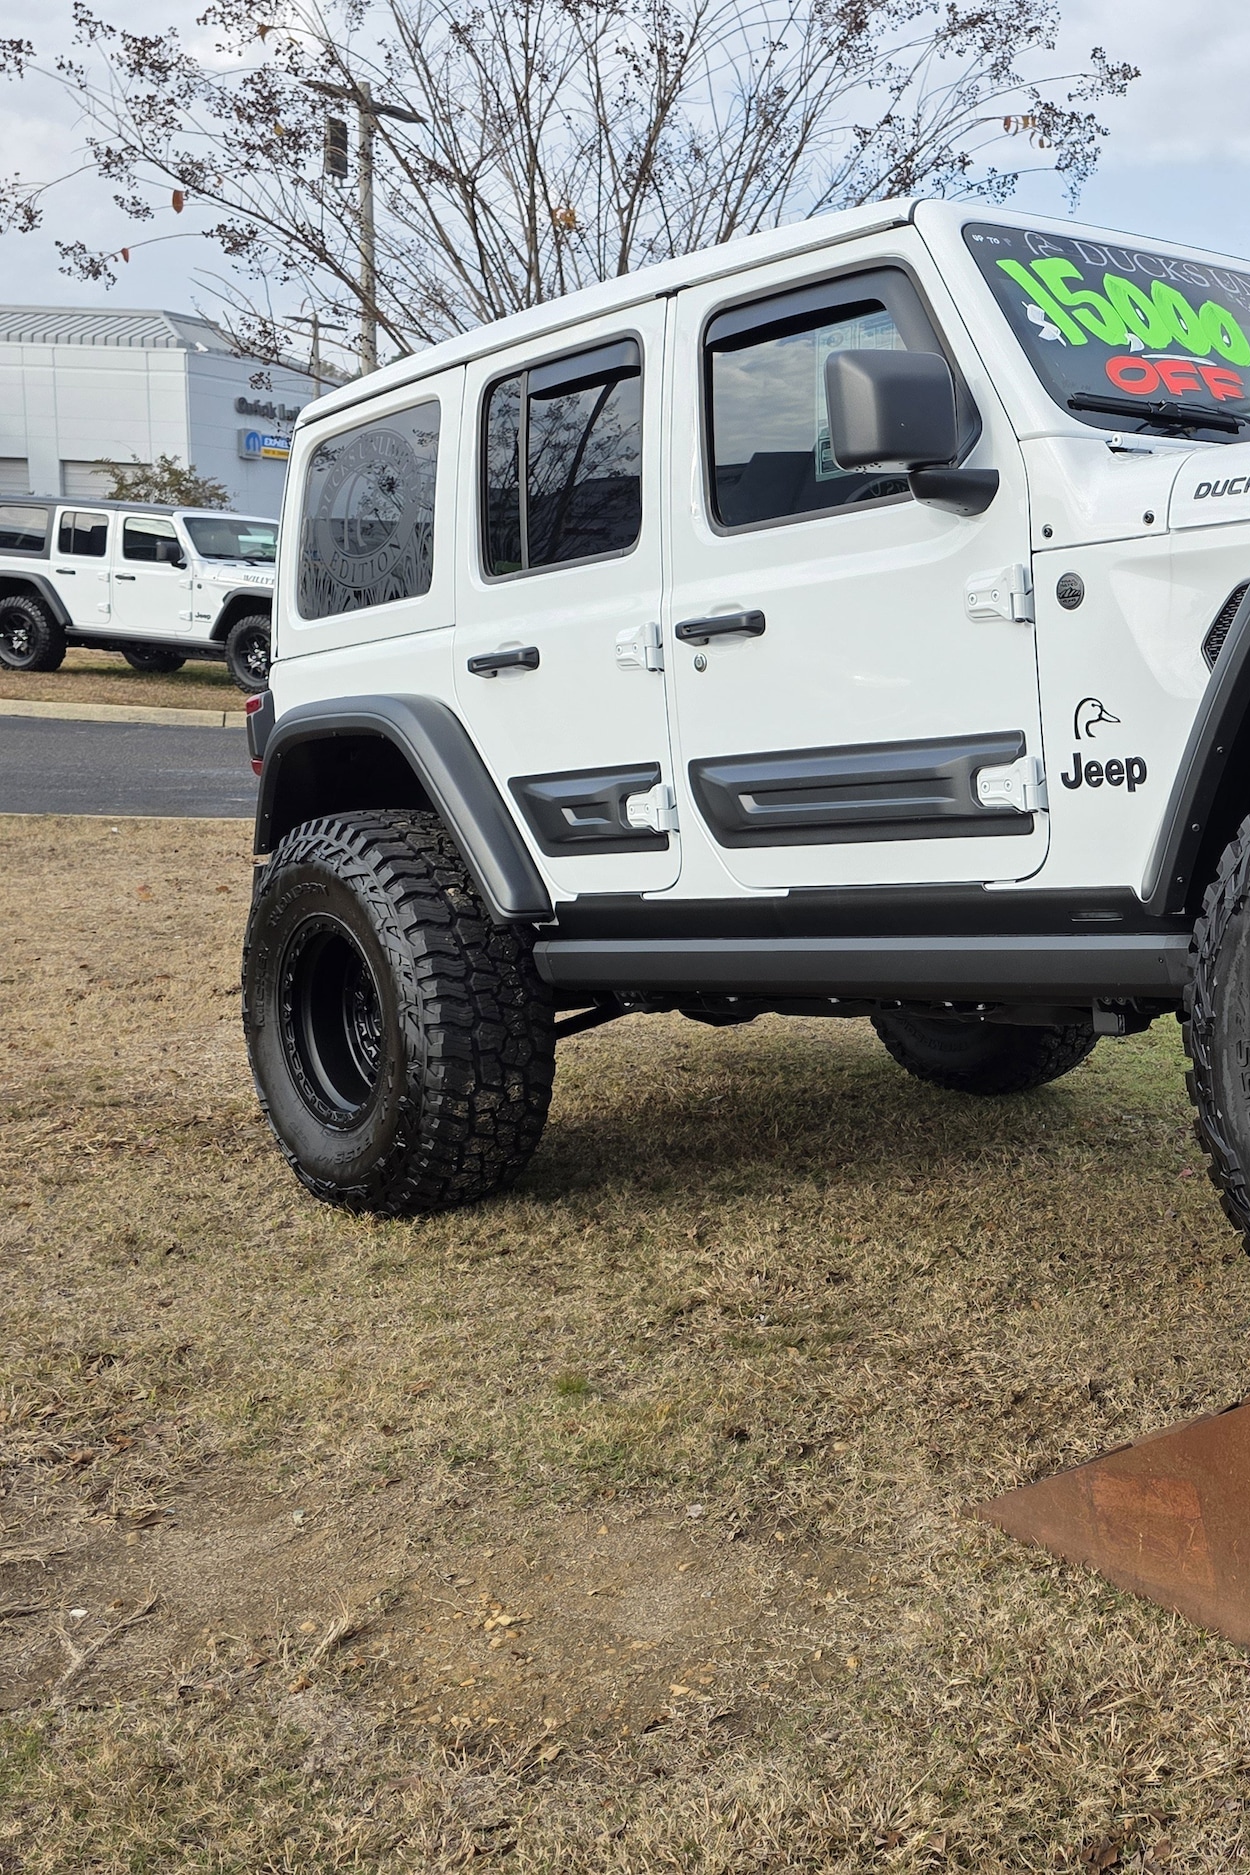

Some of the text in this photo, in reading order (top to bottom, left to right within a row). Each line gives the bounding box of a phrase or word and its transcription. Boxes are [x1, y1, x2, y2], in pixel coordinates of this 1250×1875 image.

[1072, 240, 1211, 288] DUCKS
[1105, 355, 1245, 402] OFF
[1060, 752, 1148, 793] Jeep
